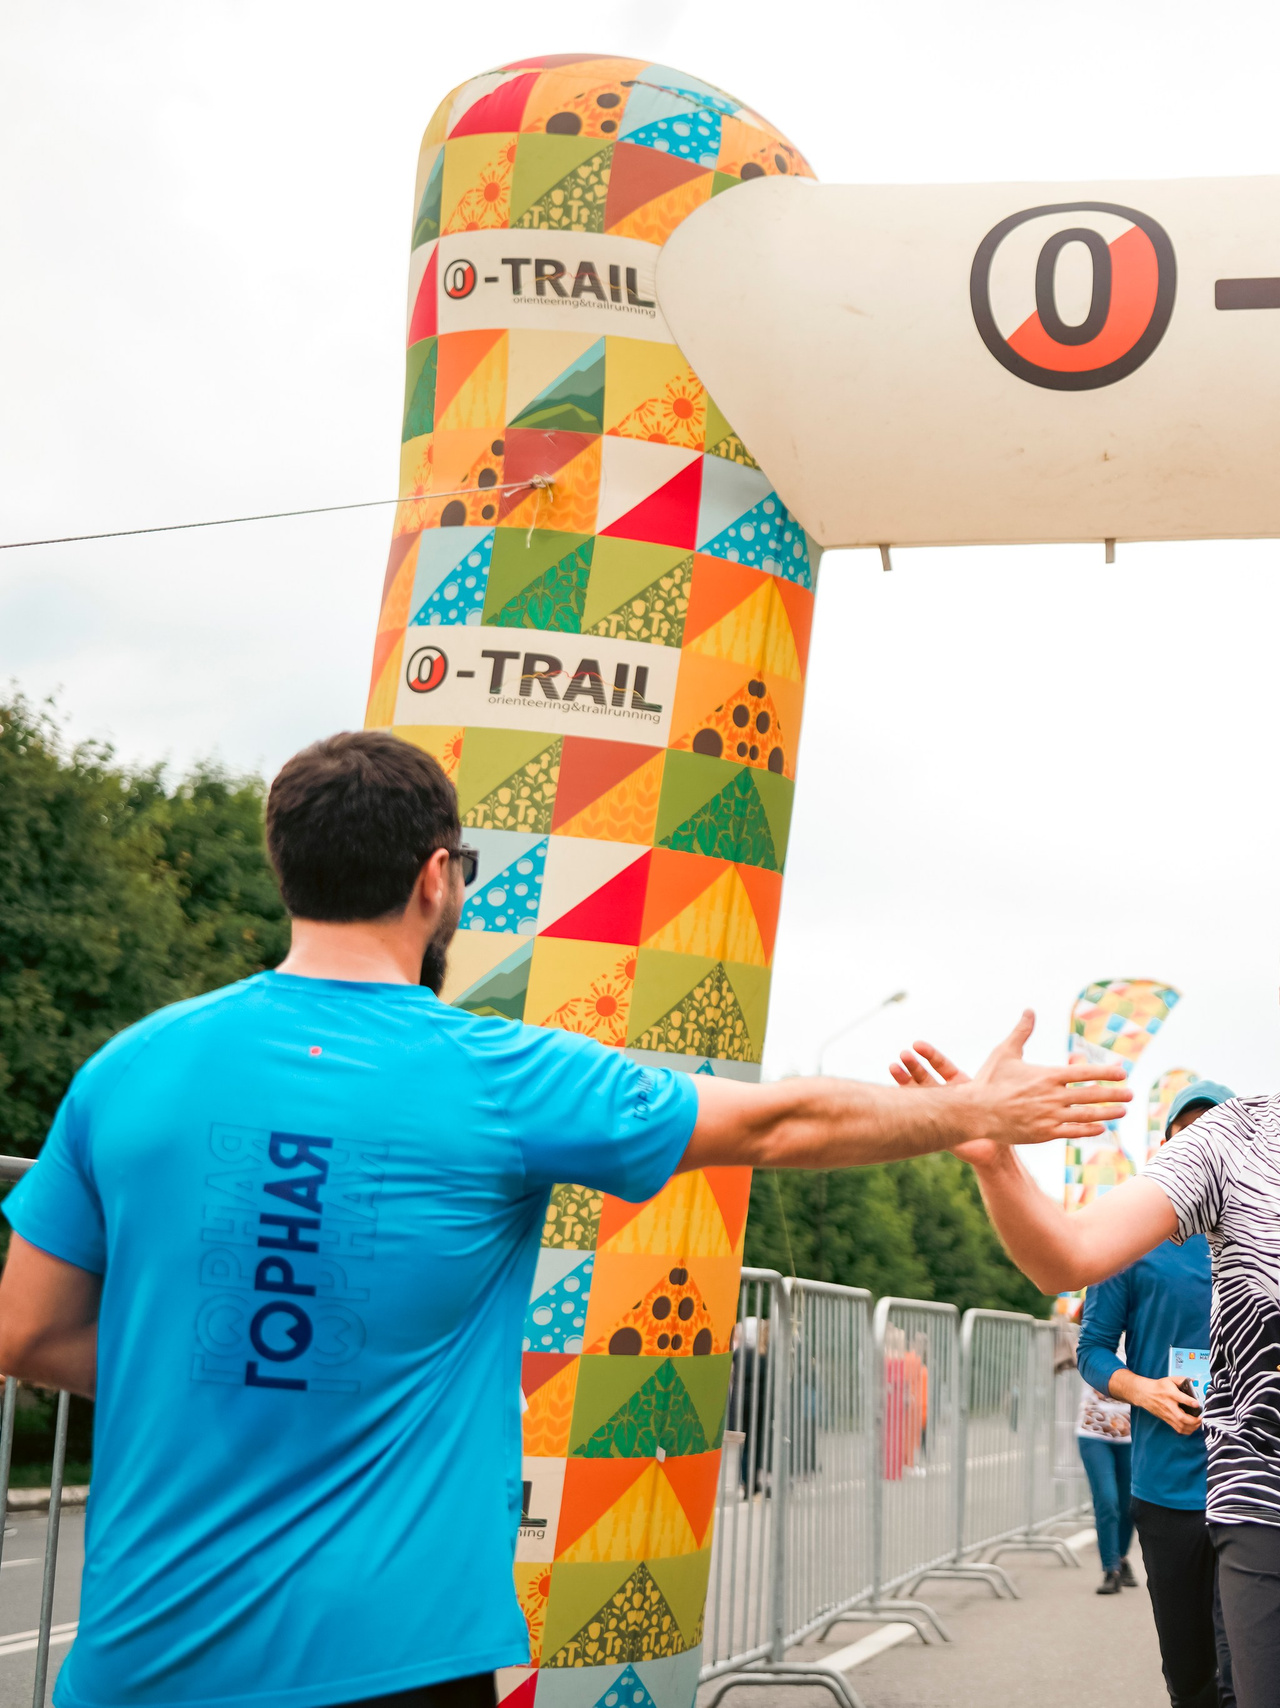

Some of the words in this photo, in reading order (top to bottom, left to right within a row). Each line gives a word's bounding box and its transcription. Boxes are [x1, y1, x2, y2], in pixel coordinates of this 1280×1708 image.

[512, 294, 656, 318] orienteering&trailrunning
[488, 695, 661, 724] orienteering&trailrunning
[244, 1131, 333, 1392] ГОРНАЯ
